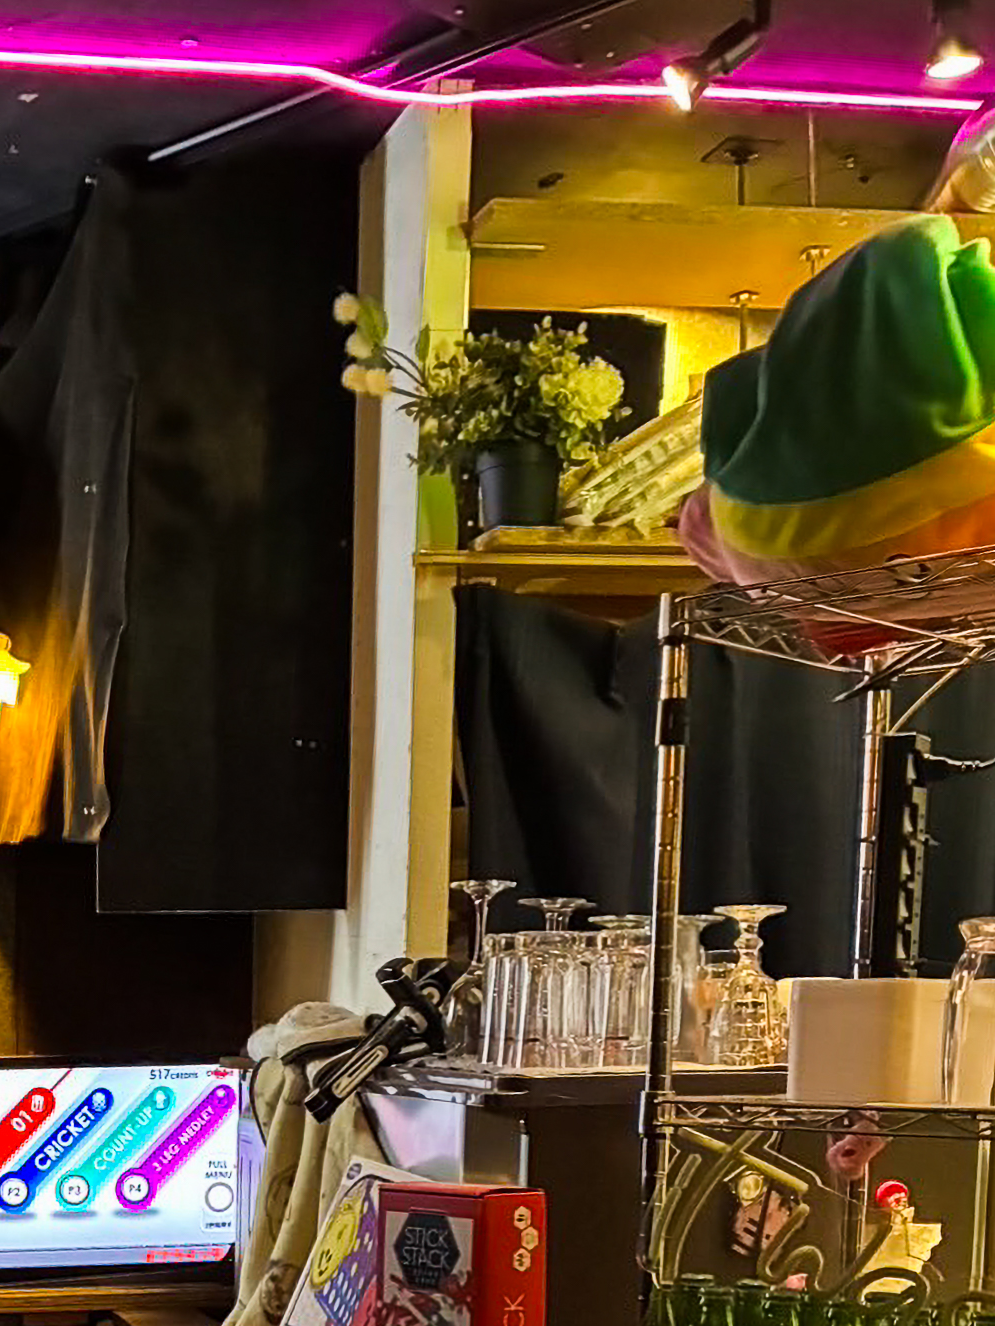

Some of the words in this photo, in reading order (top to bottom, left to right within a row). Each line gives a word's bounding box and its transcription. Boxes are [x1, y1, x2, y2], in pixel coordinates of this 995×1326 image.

[11, 1112, 35, 1133] 01
[34, 1105, 96, 1172] CRICKET
[93, 1109, 155, 1171] COUNT-UP
[7, 1187, 22, 1198] P2
[405, 1227, 449, 1249] STICK
[402, 1246, 450, 1270] STACK
